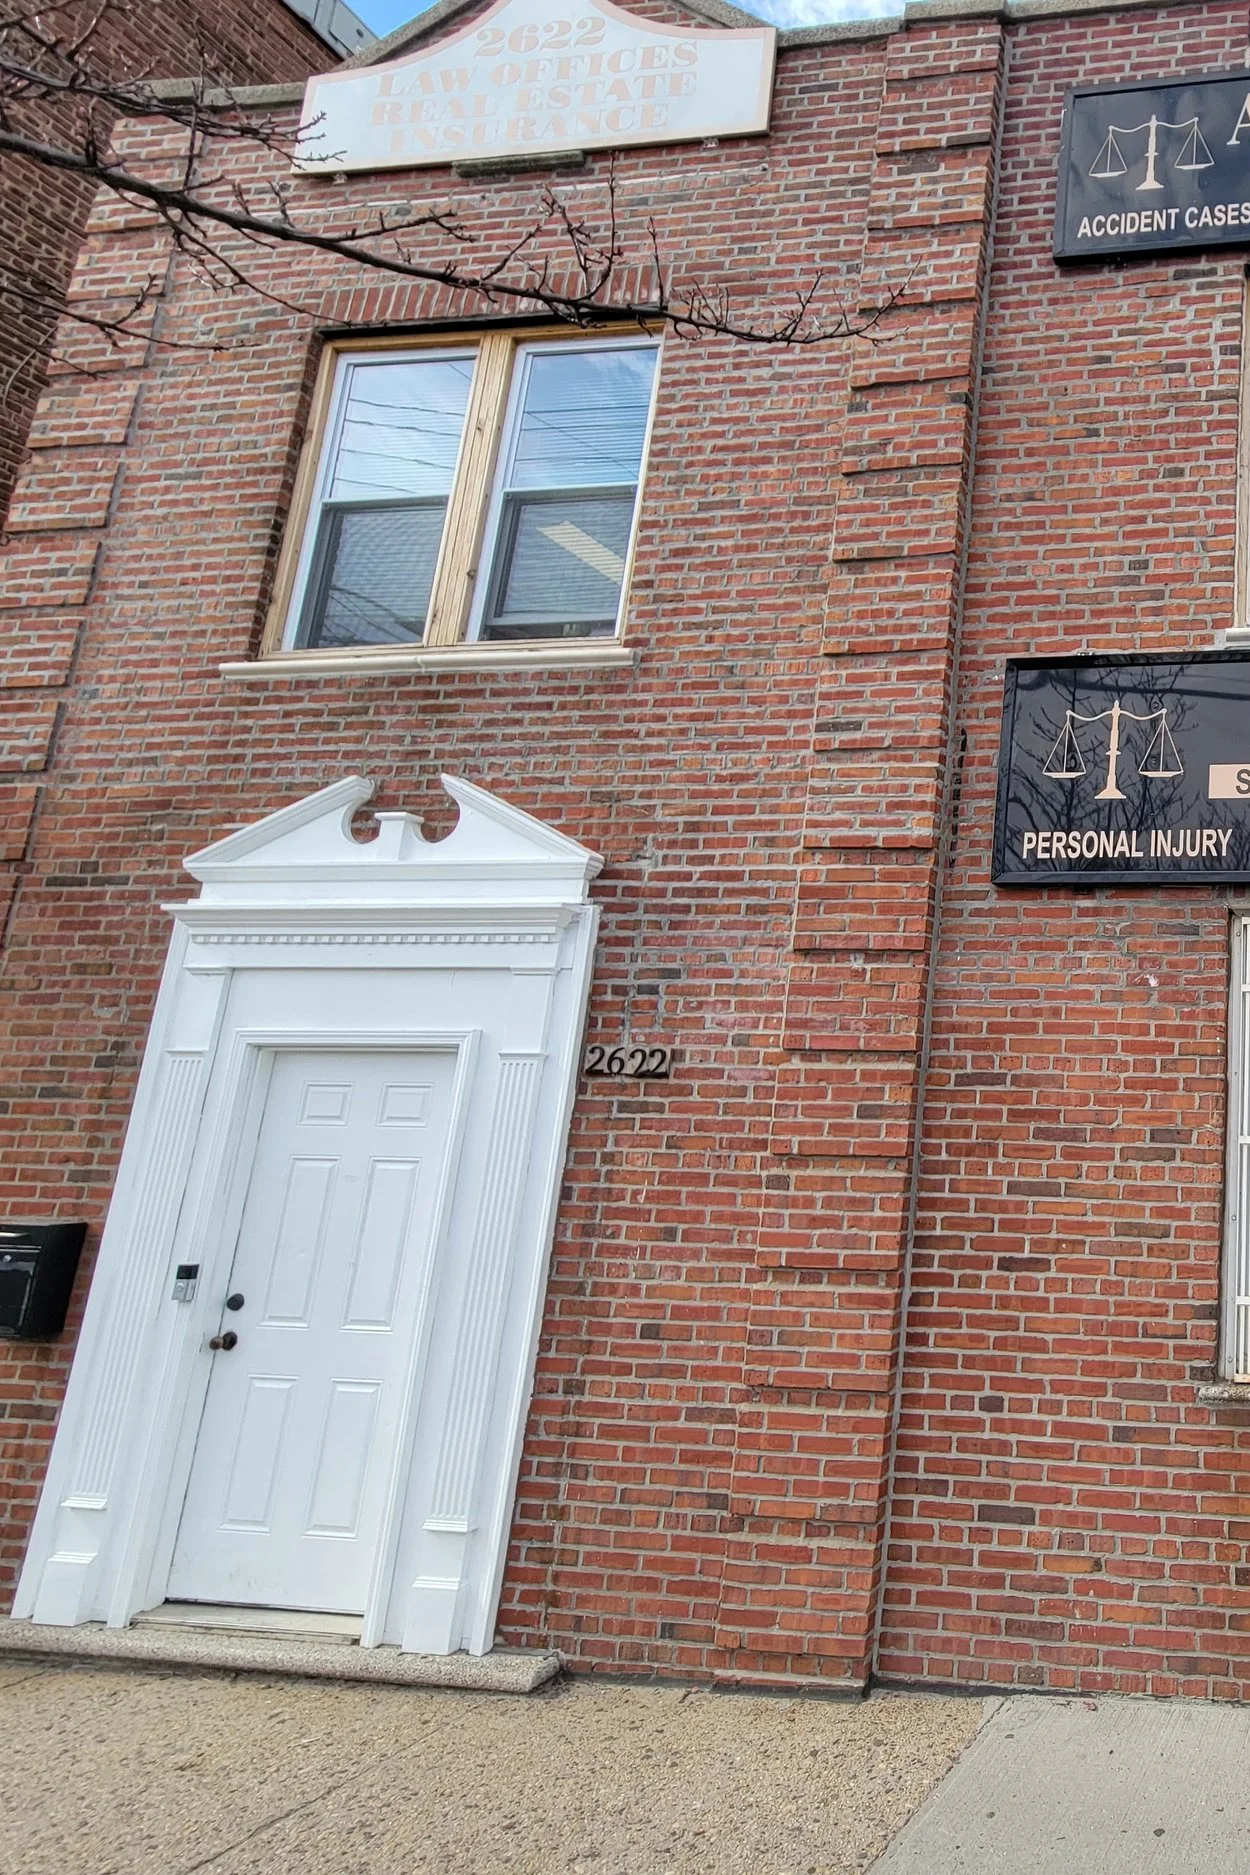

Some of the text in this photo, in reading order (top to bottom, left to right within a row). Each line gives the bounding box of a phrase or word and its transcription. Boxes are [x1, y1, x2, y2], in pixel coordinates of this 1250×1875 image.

[473, 16, 609, 58] 2622
[376, 41, 699, 98] LAW OFFICES
[369, 71, 698, 127] REAL ESTATE
[390, 103, 669, 153] INSURANCE
[1076, 206, 1180, 239] ACCIDENT
[1021, 828, 1234, 860] PERSONAL INJURY
[585, 1046, 670, 1078] 2622
